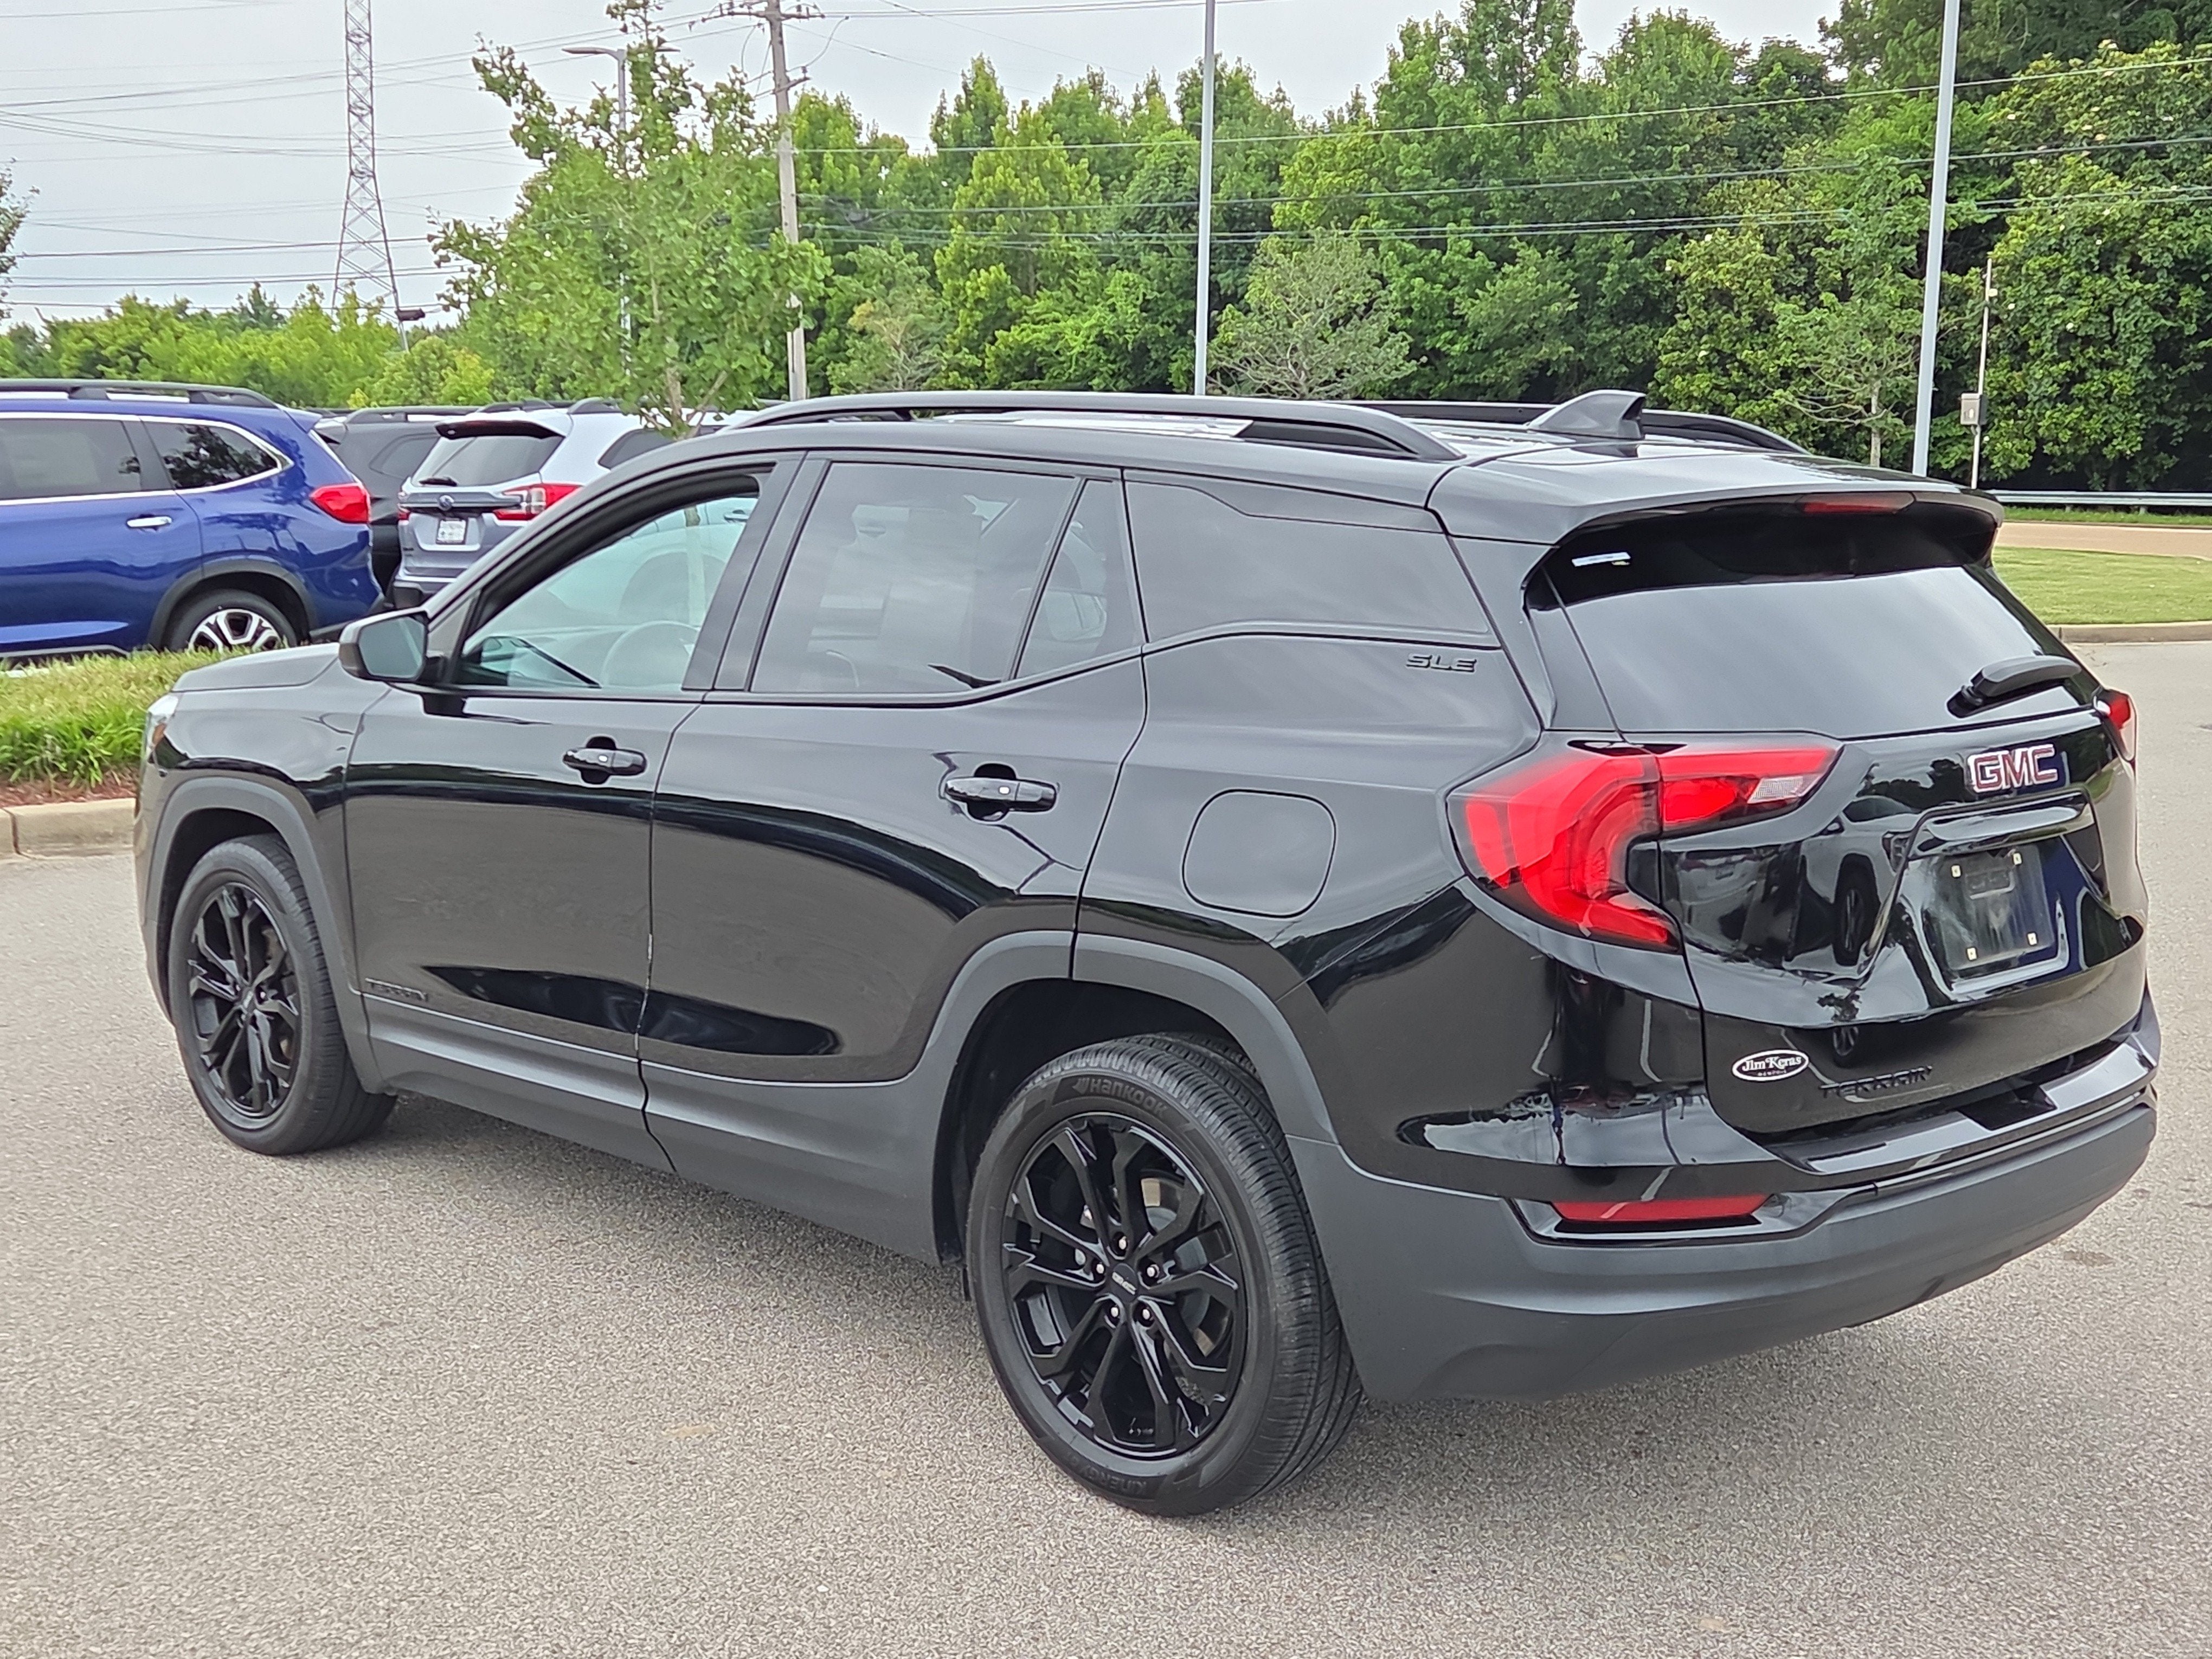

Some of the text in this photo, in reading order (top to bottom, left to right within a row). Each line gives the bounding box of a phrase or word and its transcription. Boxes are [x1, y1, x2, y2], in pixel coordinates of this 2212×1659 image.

[1407, 654, 1477, 672] SLE
[1967, 744, 2058, 793] GMC
[1741, 1056, 1802, 1071] Jim Keras
